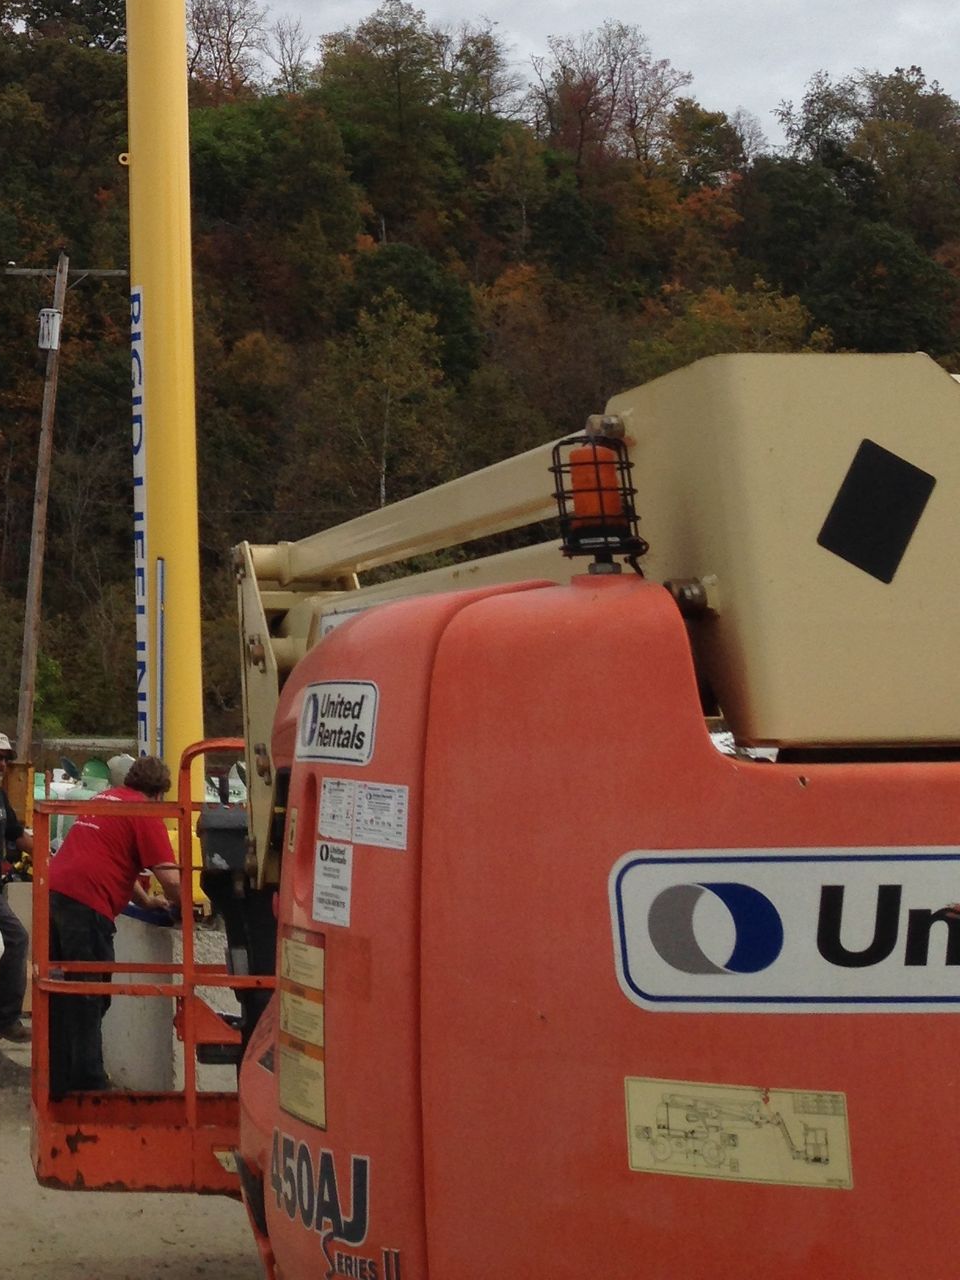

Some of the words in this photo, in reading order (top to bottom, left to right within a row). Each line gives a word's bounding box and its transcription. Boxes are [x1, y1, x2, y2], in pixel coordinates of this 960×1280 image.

[320, 693, 365, 719] United
[316, 722, 366, 749] Rentals
[271, 1127, 370, 1246] 450AJ
